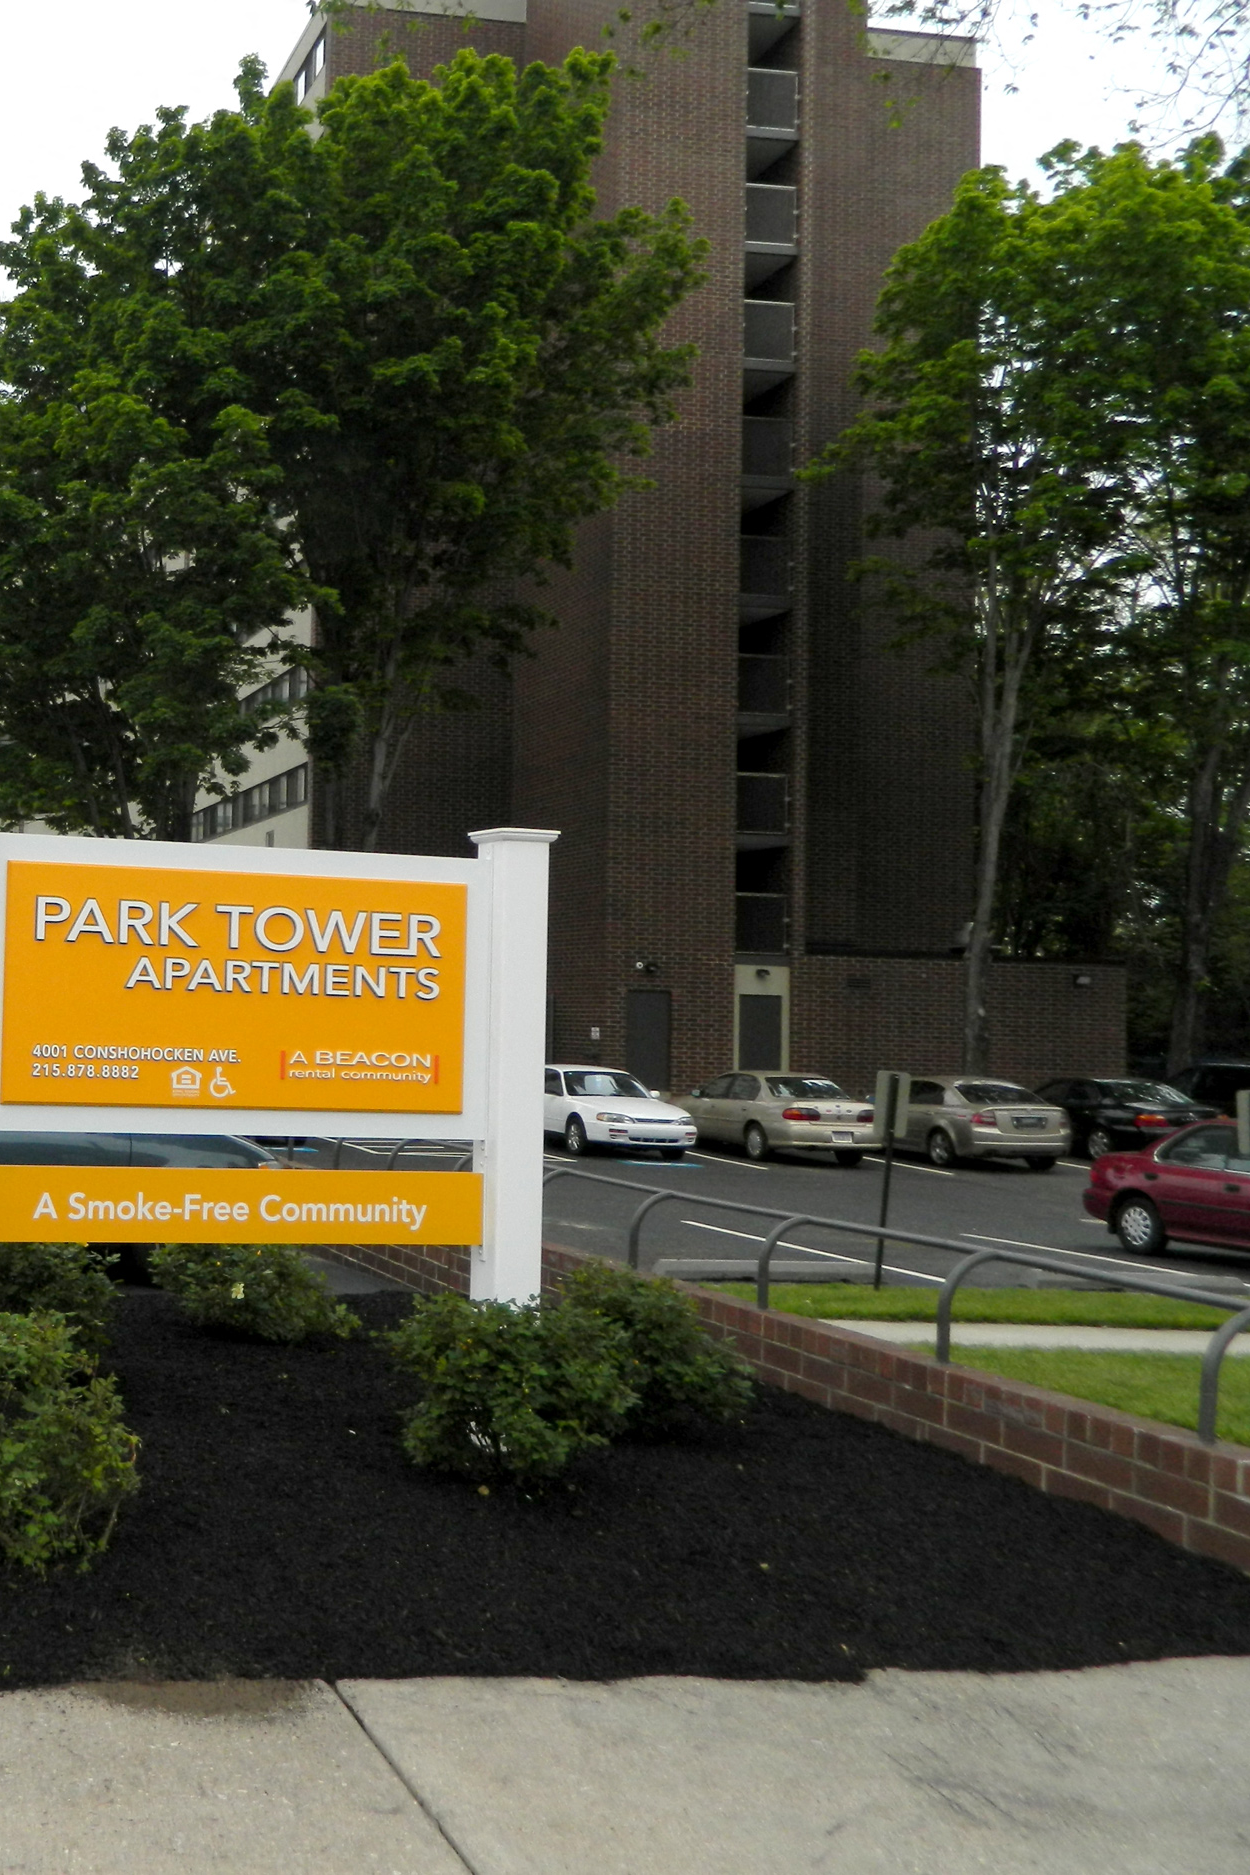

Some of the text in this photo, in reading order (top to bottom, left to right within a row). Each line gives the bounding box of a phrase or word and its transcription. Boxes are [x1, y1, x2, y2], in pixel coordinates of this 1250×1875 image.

[35, 895, 442, 958] PARK TOWER
[124, 956, 440, 1000] APARTMENTS
[32, 1044, 241, 1063] 4001 CONSHOHOCKEN AVE.
[289, 1051, 432, 1068] A BEACON
[31, 1063, 140, 1079] 215.878.8882
[288, 1067, 432, 1084] rental community
[33, 1192, 427, 1231] A Smoke-Free Community
